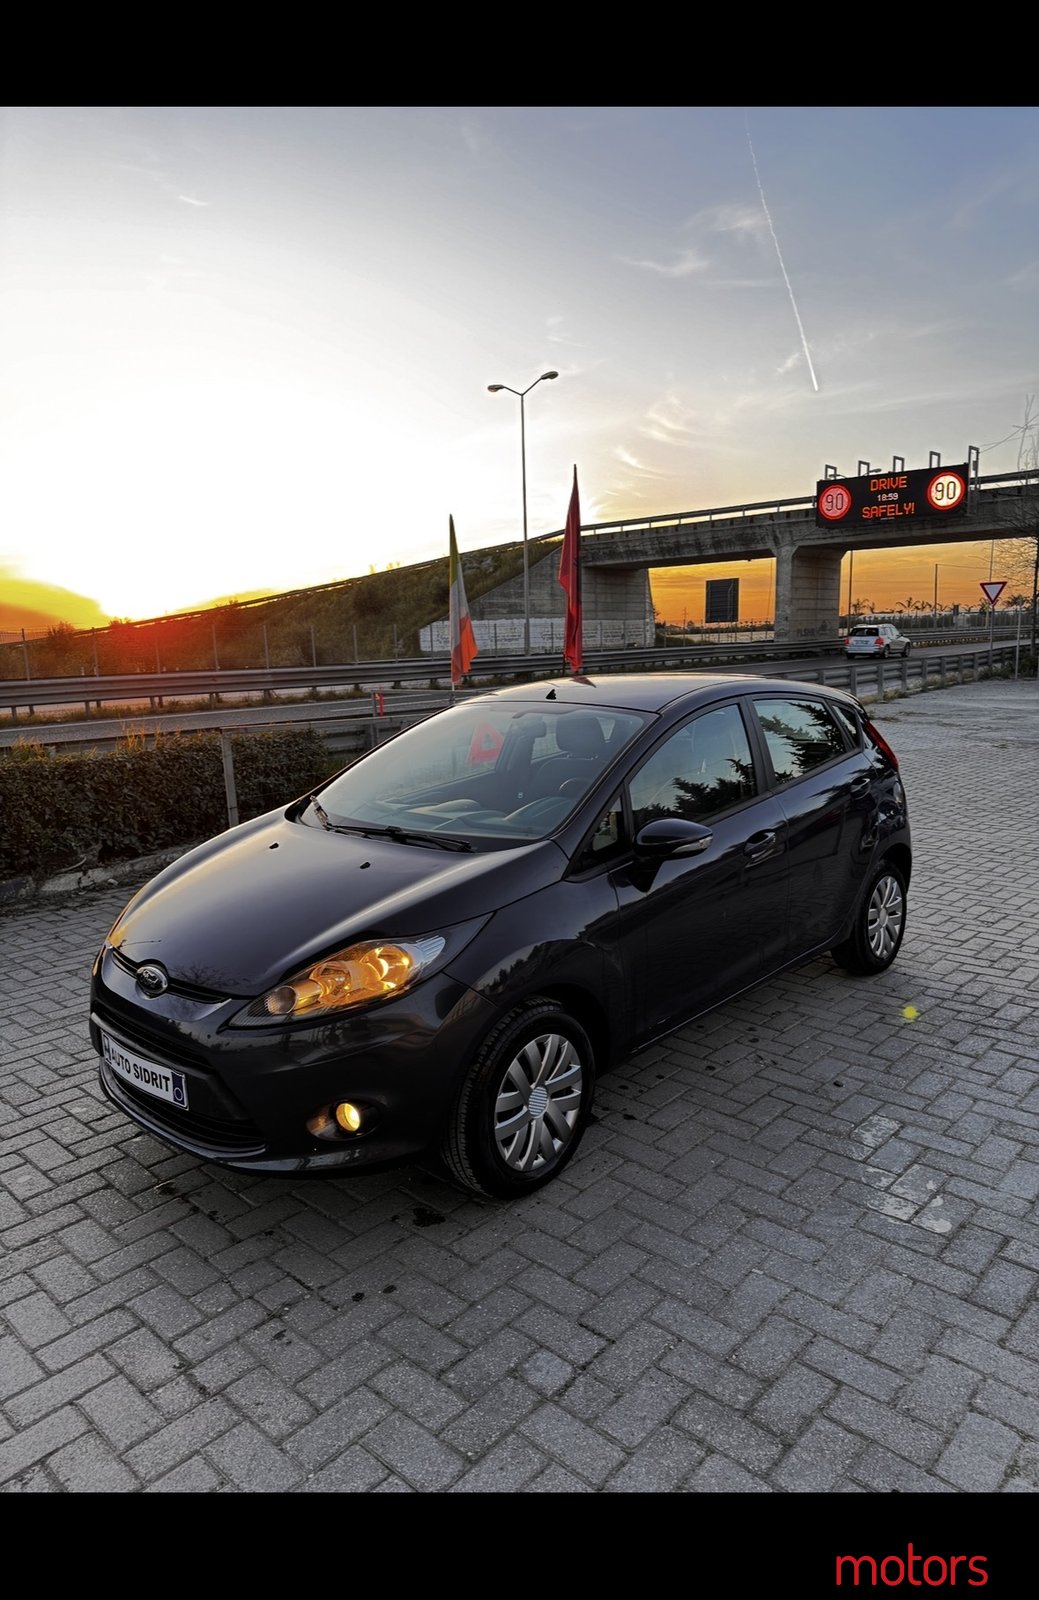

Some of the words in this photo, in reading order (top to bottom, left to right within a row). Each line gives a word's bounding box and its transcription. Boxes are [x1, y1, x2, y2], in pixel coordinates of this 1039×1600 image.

[870, 476, 908, 491] DRIVE
[935, 481, 956, 501] 90
[825, 493, 844, 511] 90
[877, 492, 899, 501] 18:59
[862, 502, 915, 519] SAFELY!
[111, 1048, 131, 1074] AUTO
[133, 1063, 171, 1092] SIDRIT
